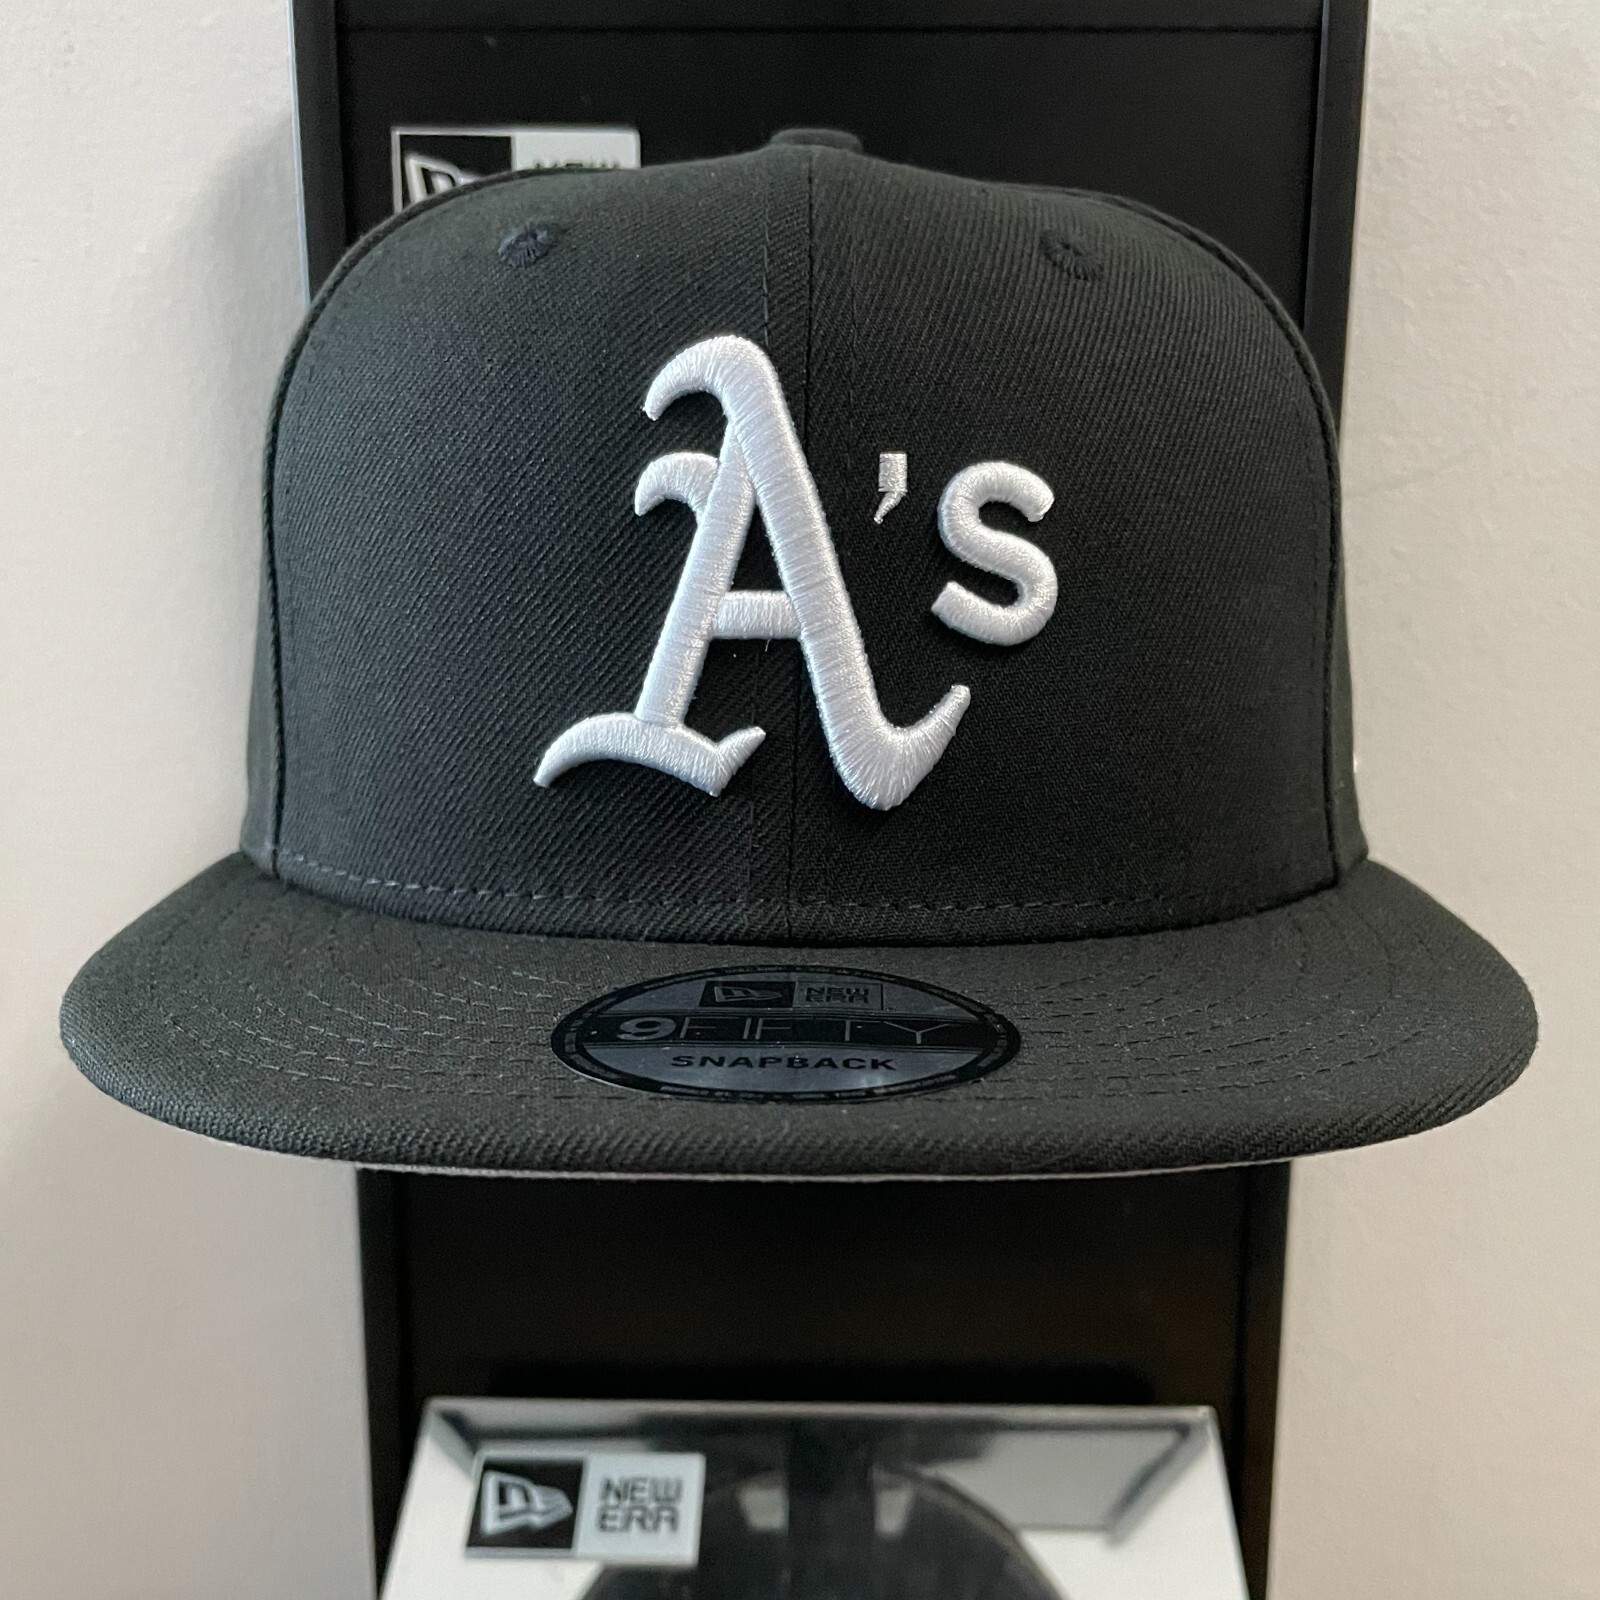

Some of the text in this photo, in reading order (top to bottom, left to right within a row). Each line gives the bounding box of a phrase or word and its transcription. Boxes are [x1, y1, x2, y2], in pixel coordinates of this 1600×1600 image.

[534, 335, 1058, 811] A's
[805, 986, 870, 995] NEW
[618, 1016, 957, 1045] 9FIFTY
[671, 1055, 896, 1070] SNAPBACK
[601, 1476, 683, 1503] NEW
[598, 1504, 680, 1533] ERA
